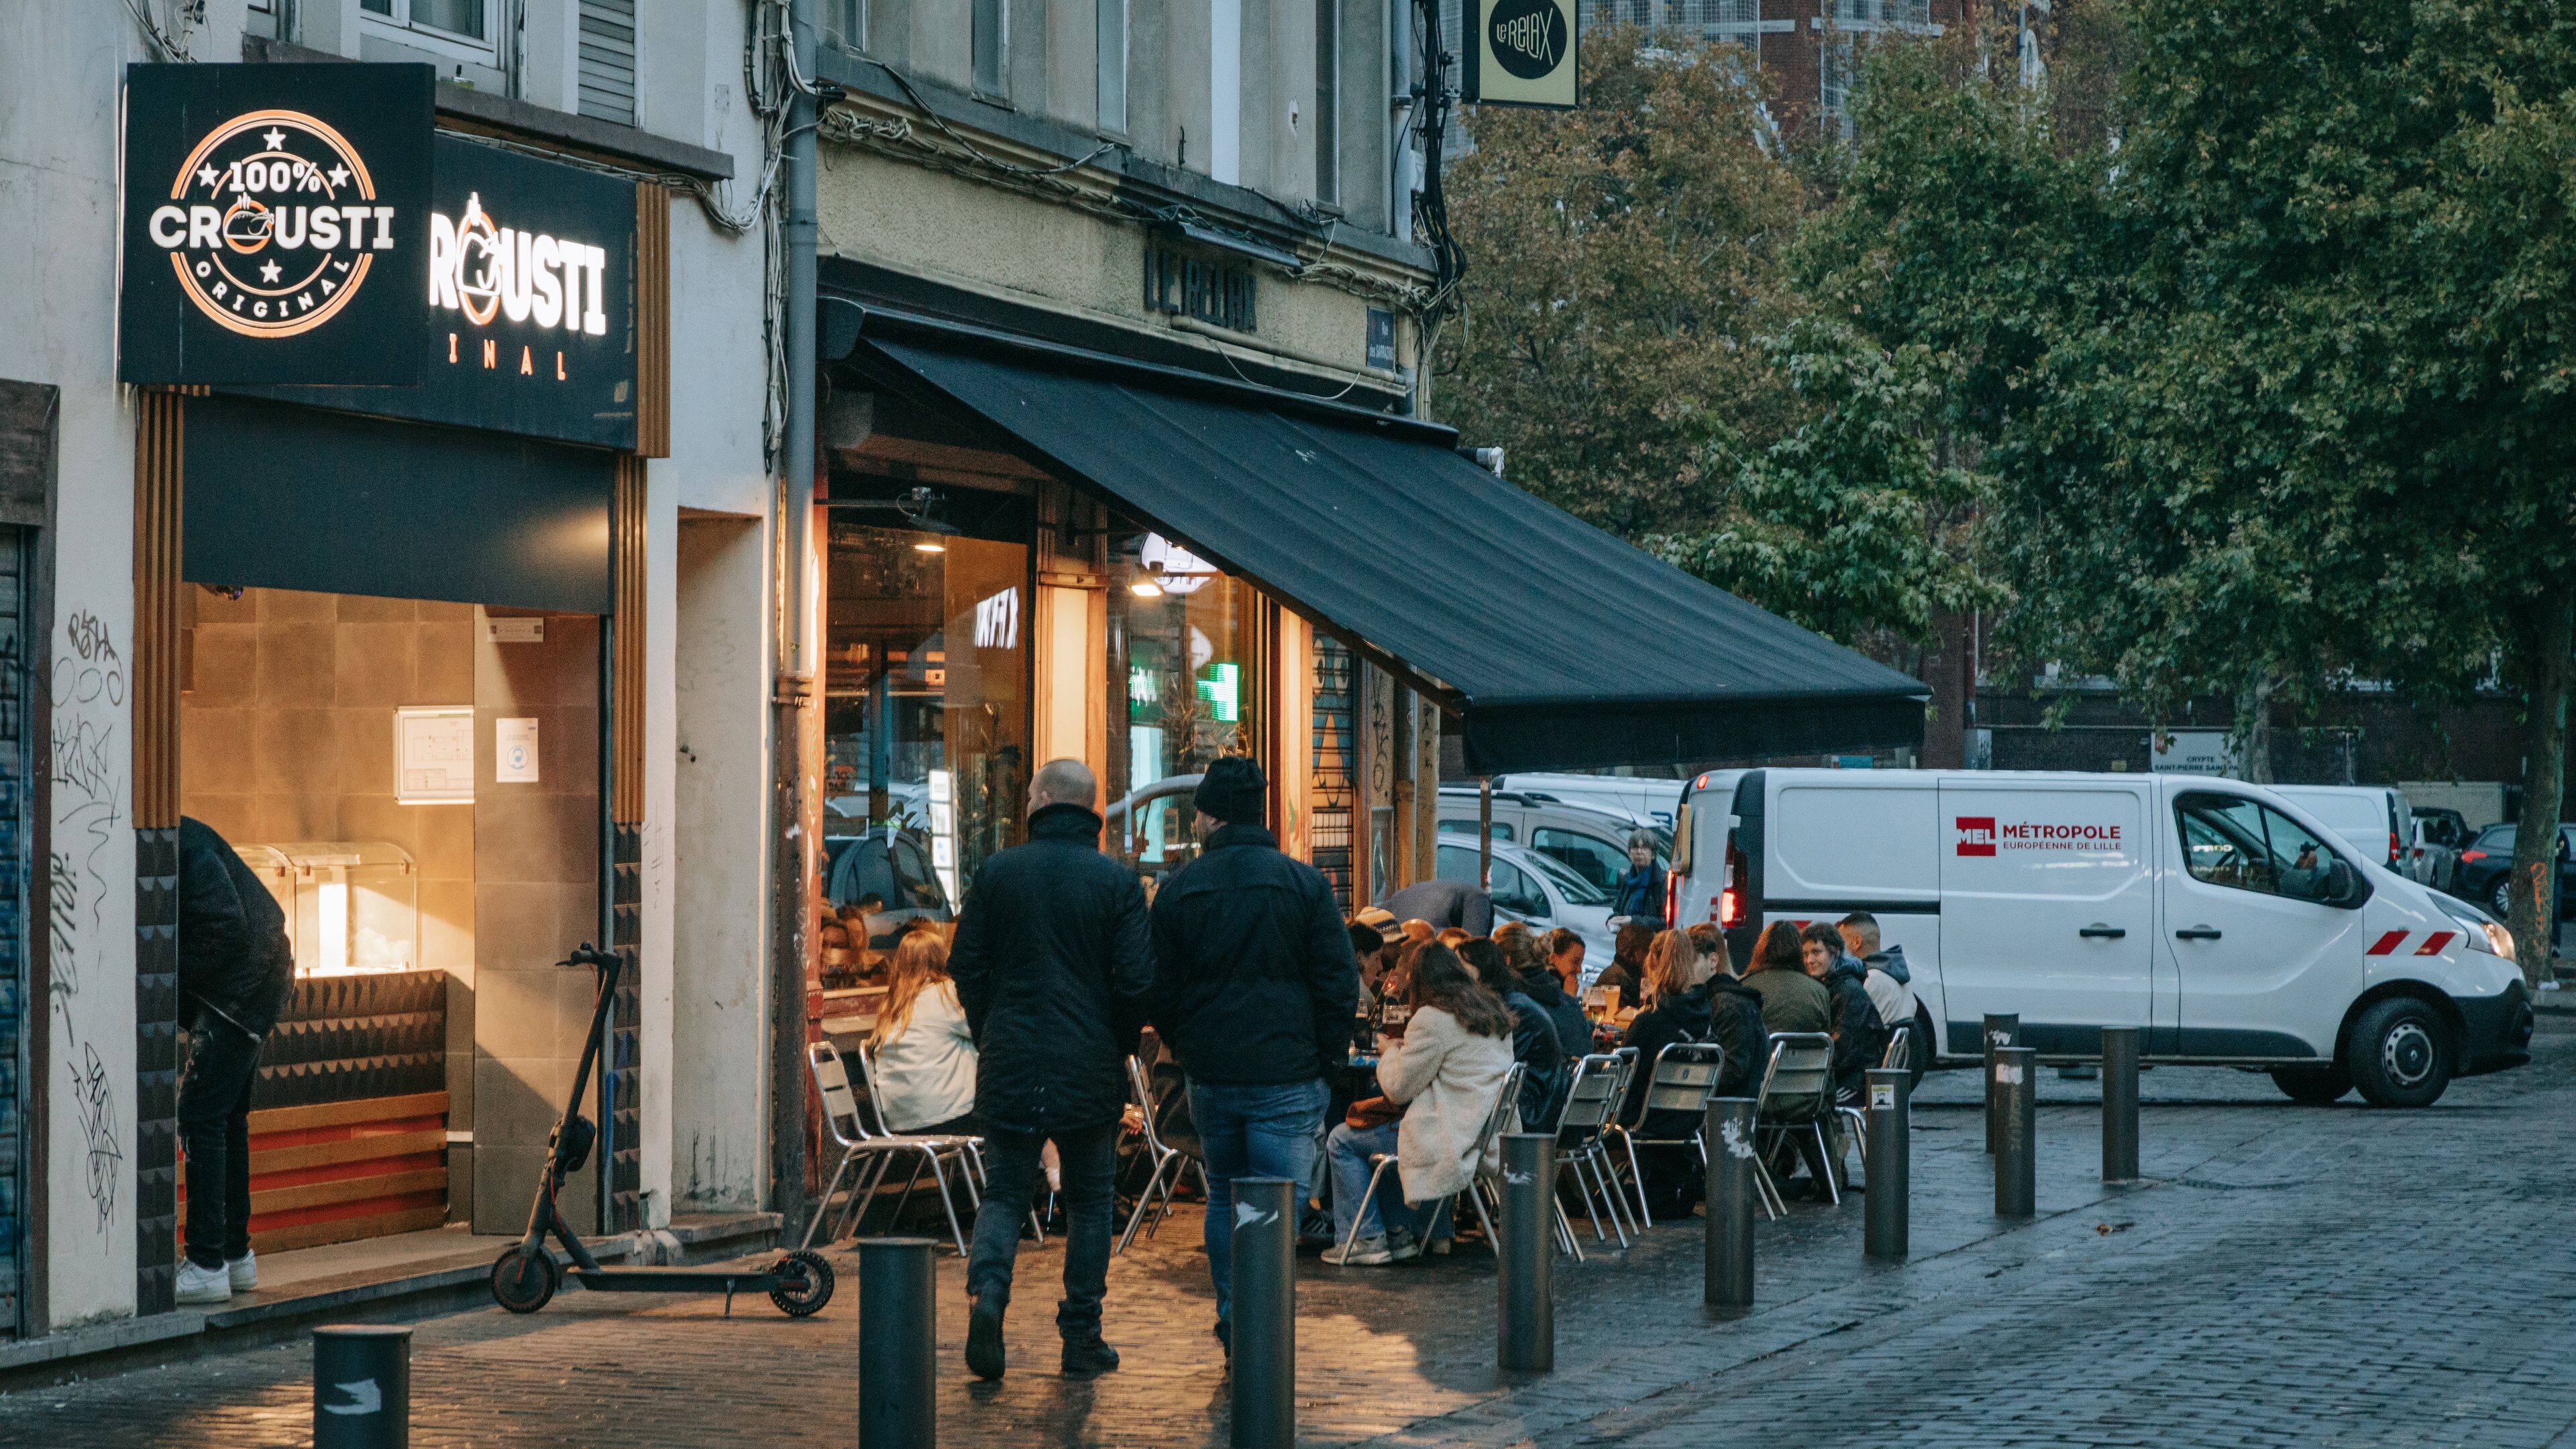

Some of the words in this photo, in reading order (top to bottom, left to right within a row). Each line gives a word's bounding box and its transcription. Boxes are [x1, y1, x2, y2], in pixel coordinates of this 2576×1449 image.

[229, 161, 321, 193] 100%
[149, 201, 394, 254] CROUSTI
[196, 259, 350, 319] ORIGINAL
[429, 209, 607, 335] ROUSTI
[448, 333, 568, 381] INAL
[2002, 821, 2121, 839] MÉTROPOLE
[2003, 840, 2074, 850] EUROPÉENNE
[2077, 842, 2090, 850] DE
[2094, 842, 2121, 850] LILLE
